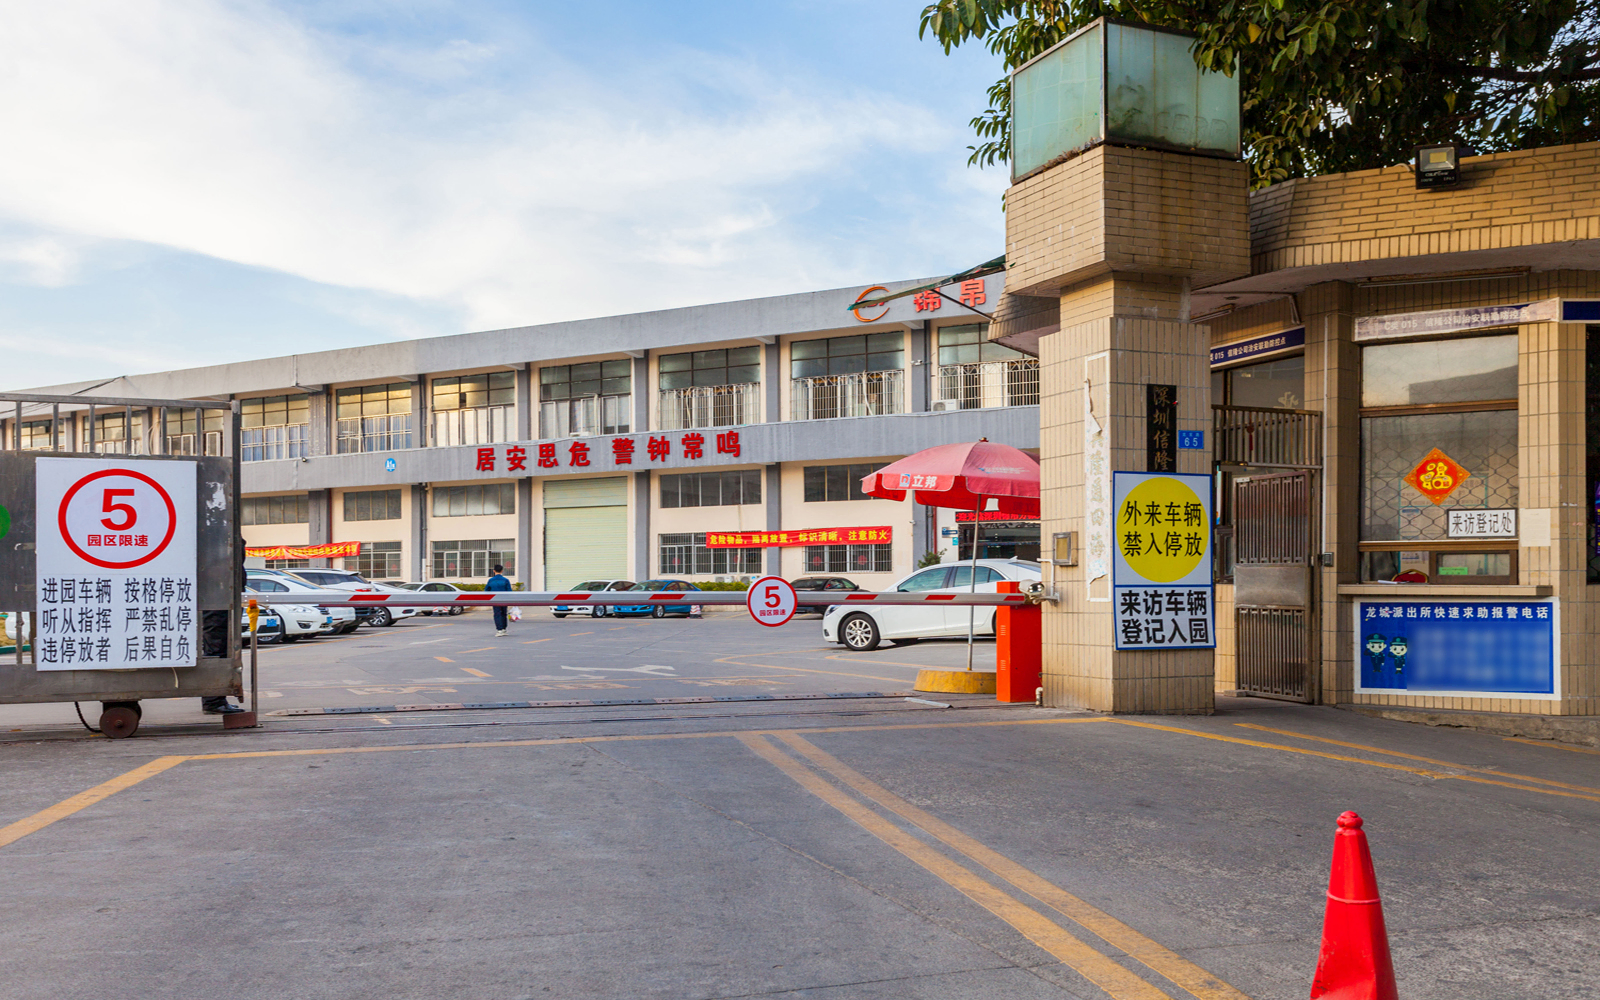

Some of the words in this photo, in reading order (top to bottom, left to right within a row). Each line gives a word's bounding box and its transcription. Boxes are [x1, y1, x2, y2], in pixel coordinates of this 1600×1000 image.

[1384, 321, 1399, 331] C类
[1401, 320, 1418, 330] 015
[1214, 351, 1224, 360] 015
[1153, 386, 1173, 470] 深圳信隆
[476, 441, 591, 471] 居安思危
[611, 431, 741, 465] 警钟常鸣
[1184, 437, 1198, 447] 65
[911, 474, 938, 488] 立邦
[1420, 462, 1453, 490] 福
[100, 488, 137, 531] 5
[1123, 501, 1202, 527] 外来车辆
[1452, 511, 1513, 535] 来访登记处
[87, 534, 149, 547] 园区限速
[1123, 531, 1203, 557] 禁入停放
[41, 577, 112, 604] 进园车辆
[124, 577, 192, 604] 按格停放
[765, 586, 781, 608] 5
[1120, 589, 1207, 616] 来访车辆
[41, 607, 112, 635] 听从指挥
[124, 606, 192, 633] 严禁乱停
[1365, 606, 1549, 619] 龙城派出所快速求助报警电话
[1121, 618, 1209, 645] 登记入园
[41, 637, 111, 664] 违停放者
[123, 635, 191, 662] 后果自负
